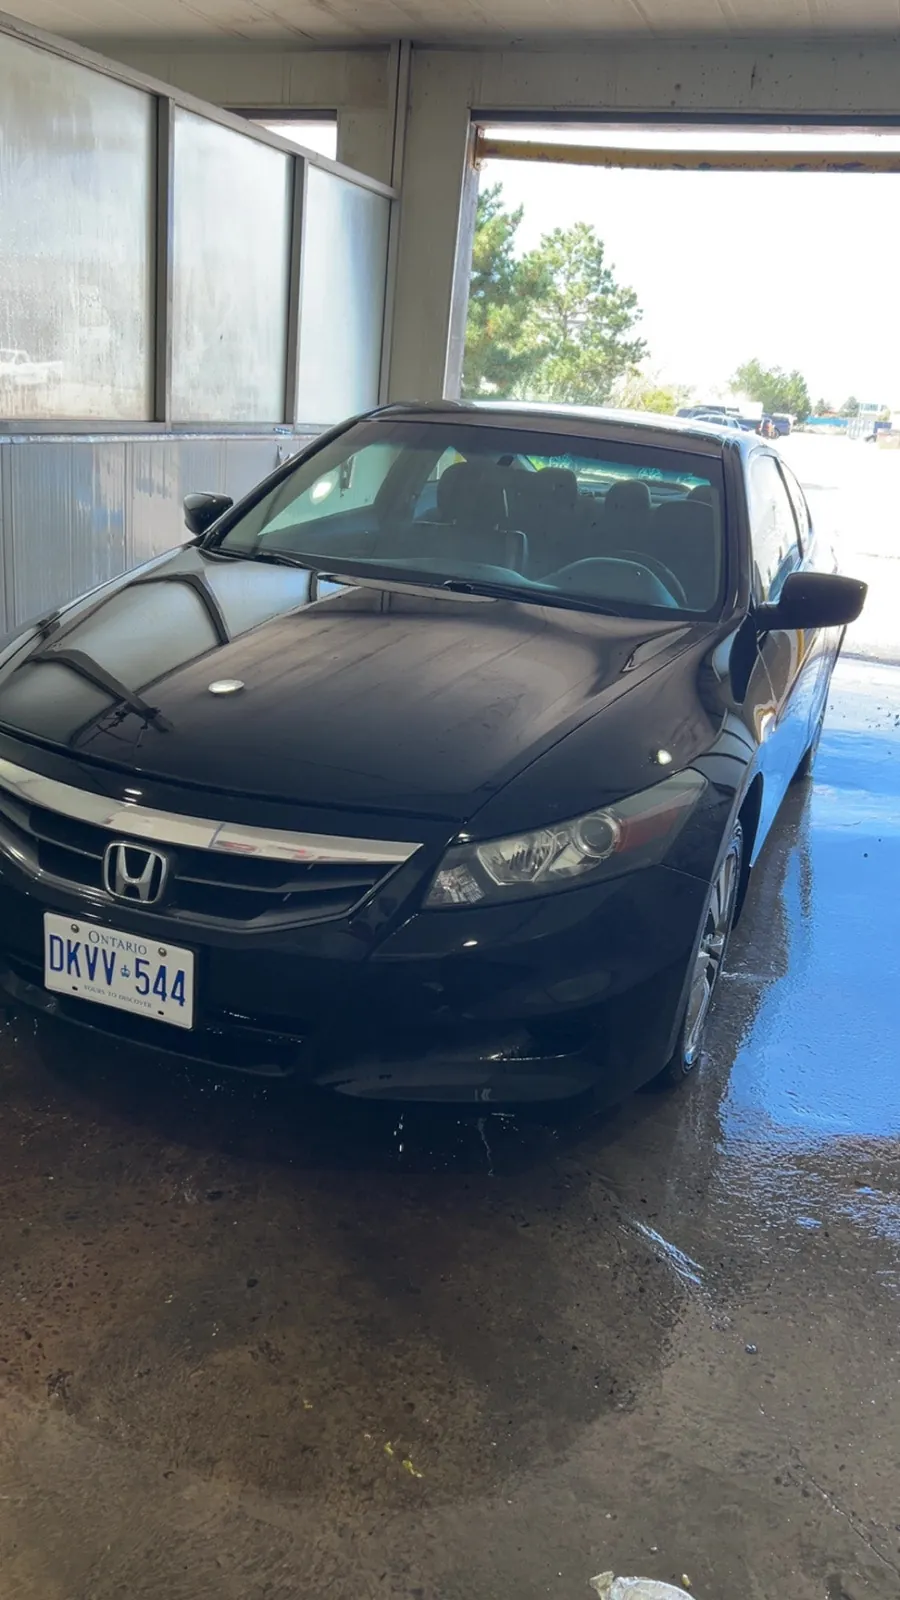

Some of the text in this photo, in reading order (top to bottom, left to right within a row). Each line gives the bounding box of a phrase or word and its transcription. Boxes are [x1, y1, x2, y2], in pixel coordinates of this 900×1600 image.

[88, 930, 148, 956] ONTARIO
[49, 934, 186, 1007] DKVV 544
[118, 994, 152, 1008] DISCOVER
